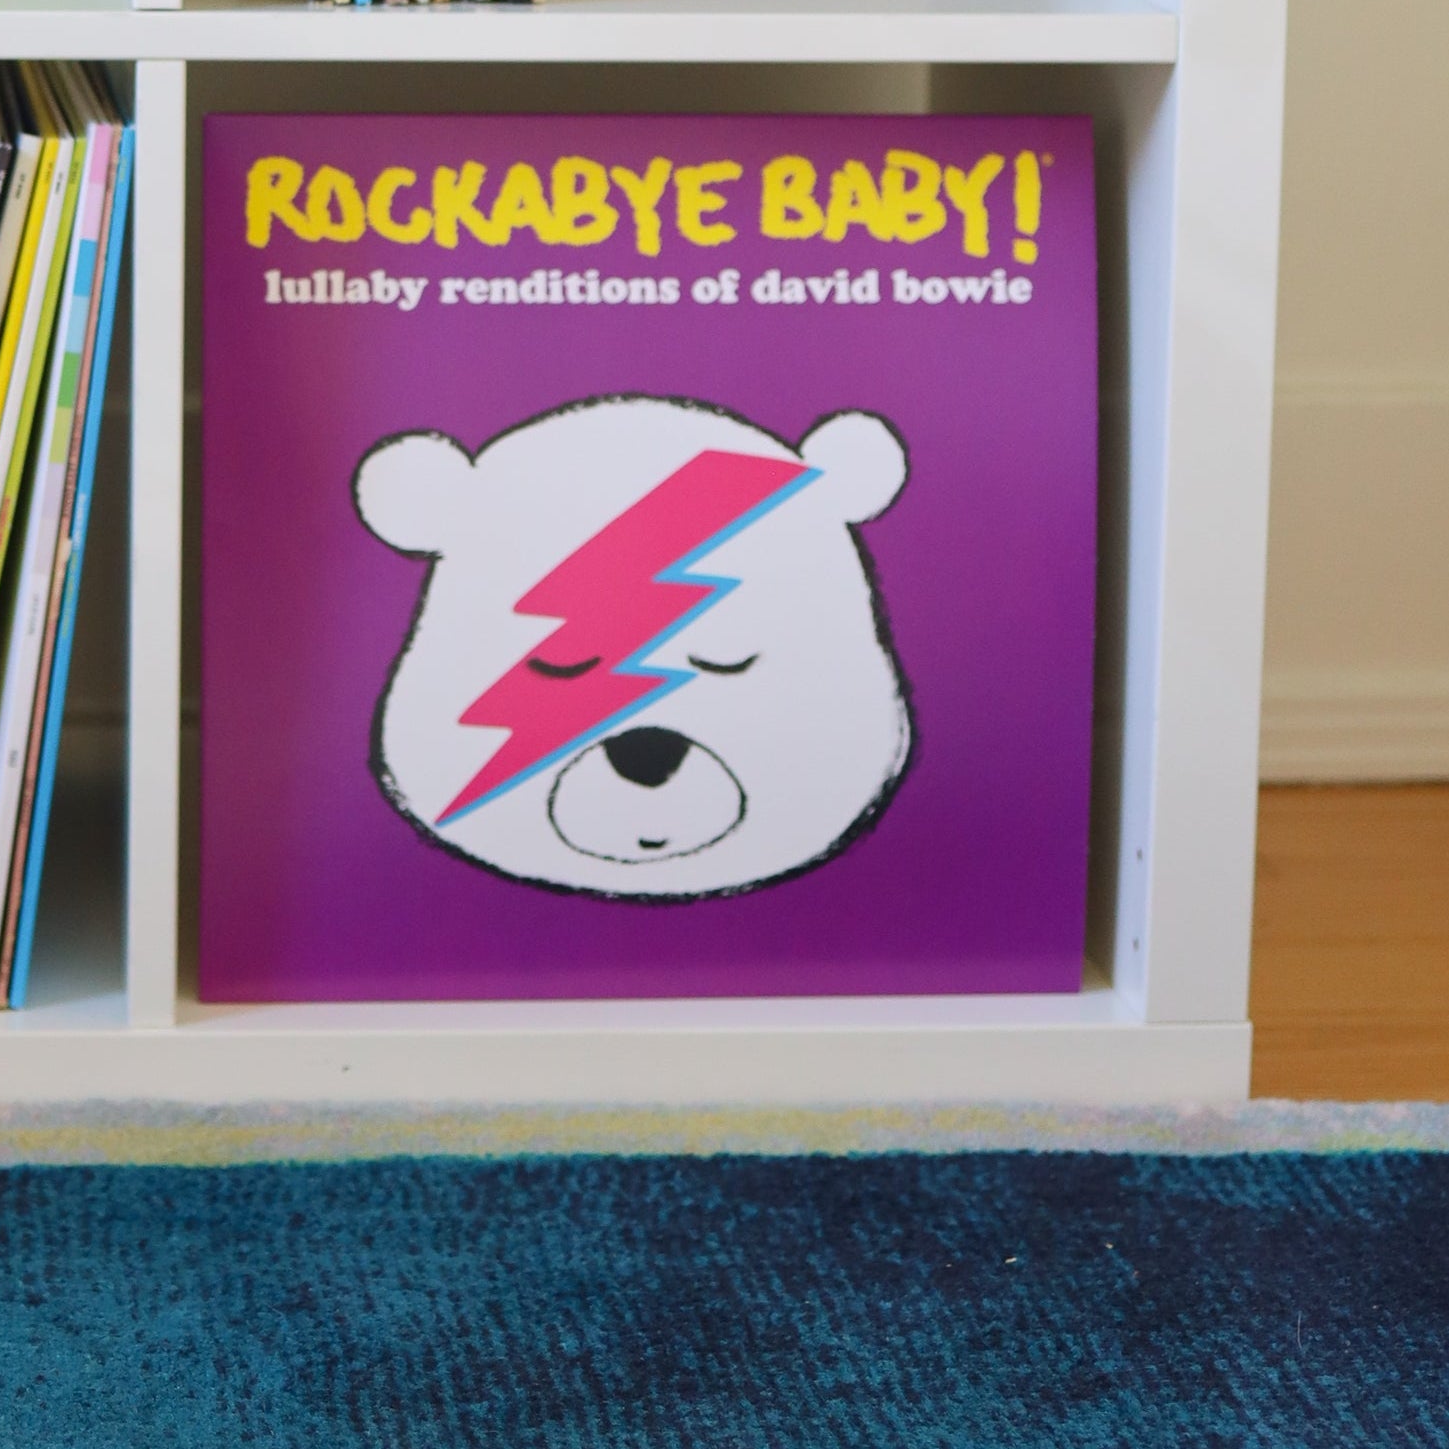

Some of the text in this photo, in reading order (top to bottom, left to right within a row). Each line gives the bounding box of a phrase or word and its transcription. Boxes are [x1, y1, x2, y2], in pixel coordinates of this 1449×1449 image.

[245, 149, 1042, 264] ROCKABYE BABY!
[264, 267, 1038, 312] lullaby renditions of david bowie
